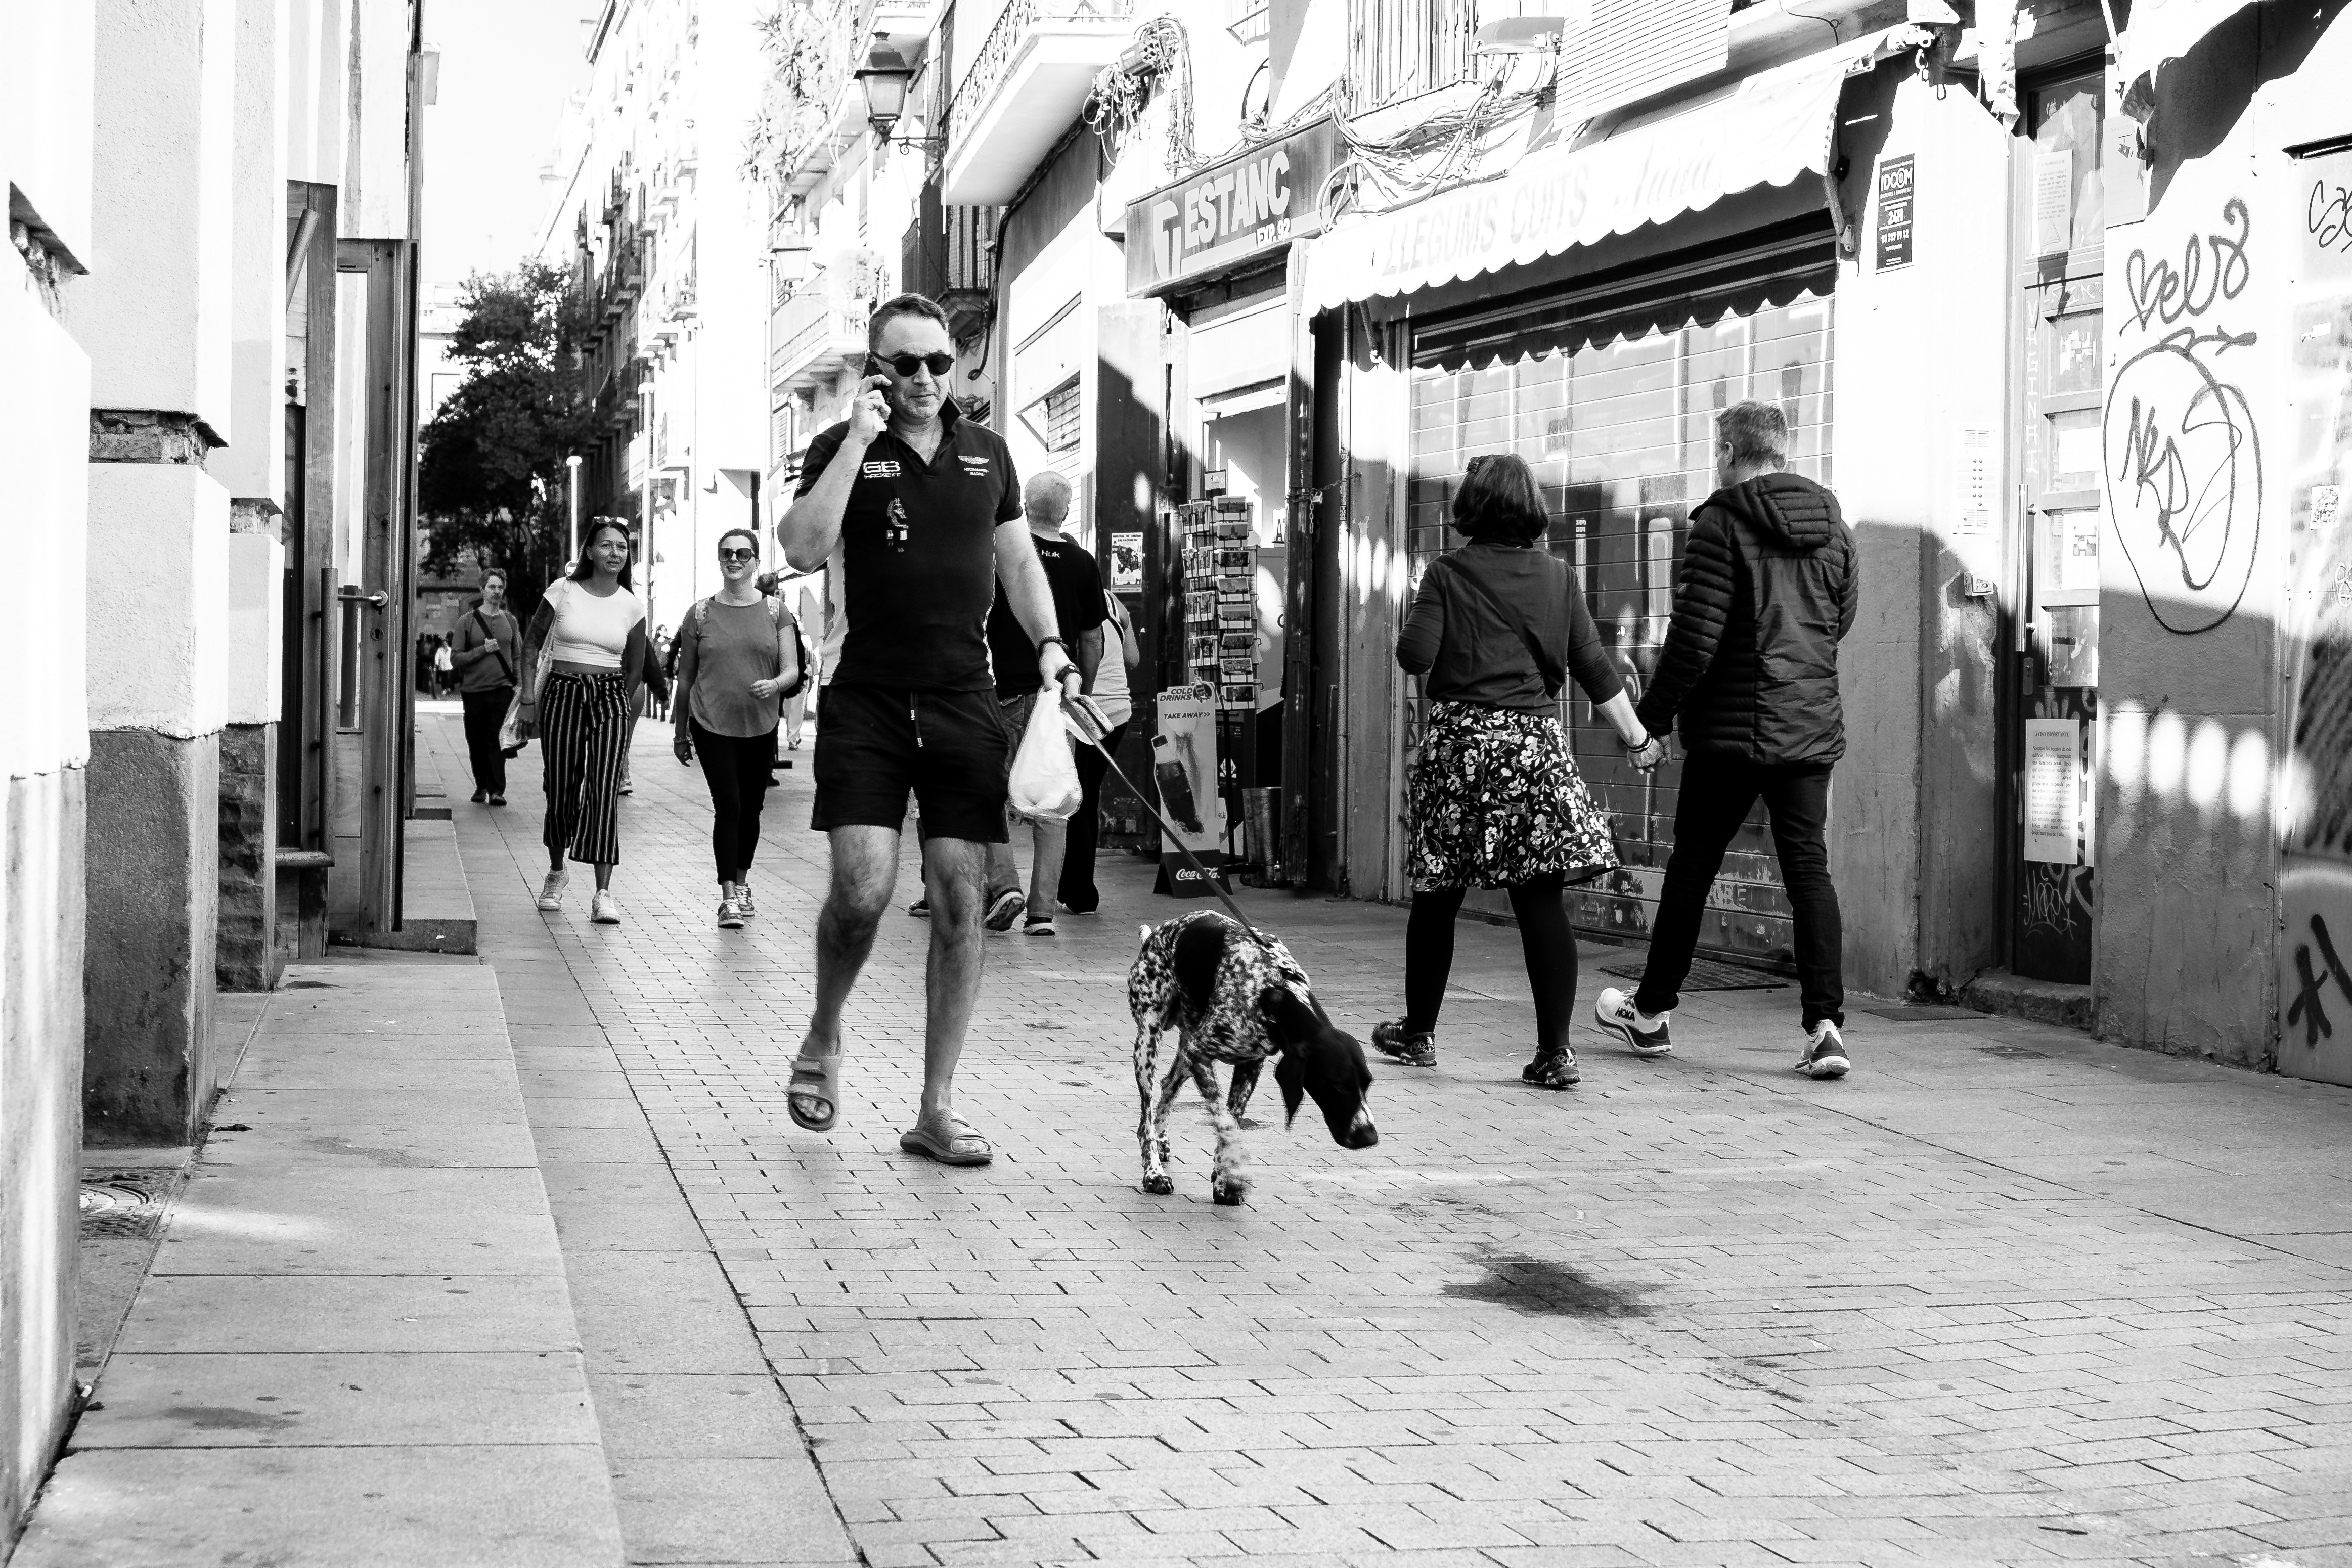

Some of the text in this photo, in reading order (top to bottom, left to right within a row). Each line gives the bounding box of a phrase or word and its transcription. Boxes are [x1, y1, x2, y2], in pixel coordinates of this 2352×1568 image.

[1881, 167, 1913, 191] IDCOM
[1185, 151, 1290, 250] ESTANC
[1382, 192, 1498, 276] LLEGUMS
[1510, 162, 1590, 245] CUITS
[1888, 208, 1903, 225] 24H
[1257, 218, 1290, 248] EXP. 92
[1615, 1006, 1635, 1022] HOKA
